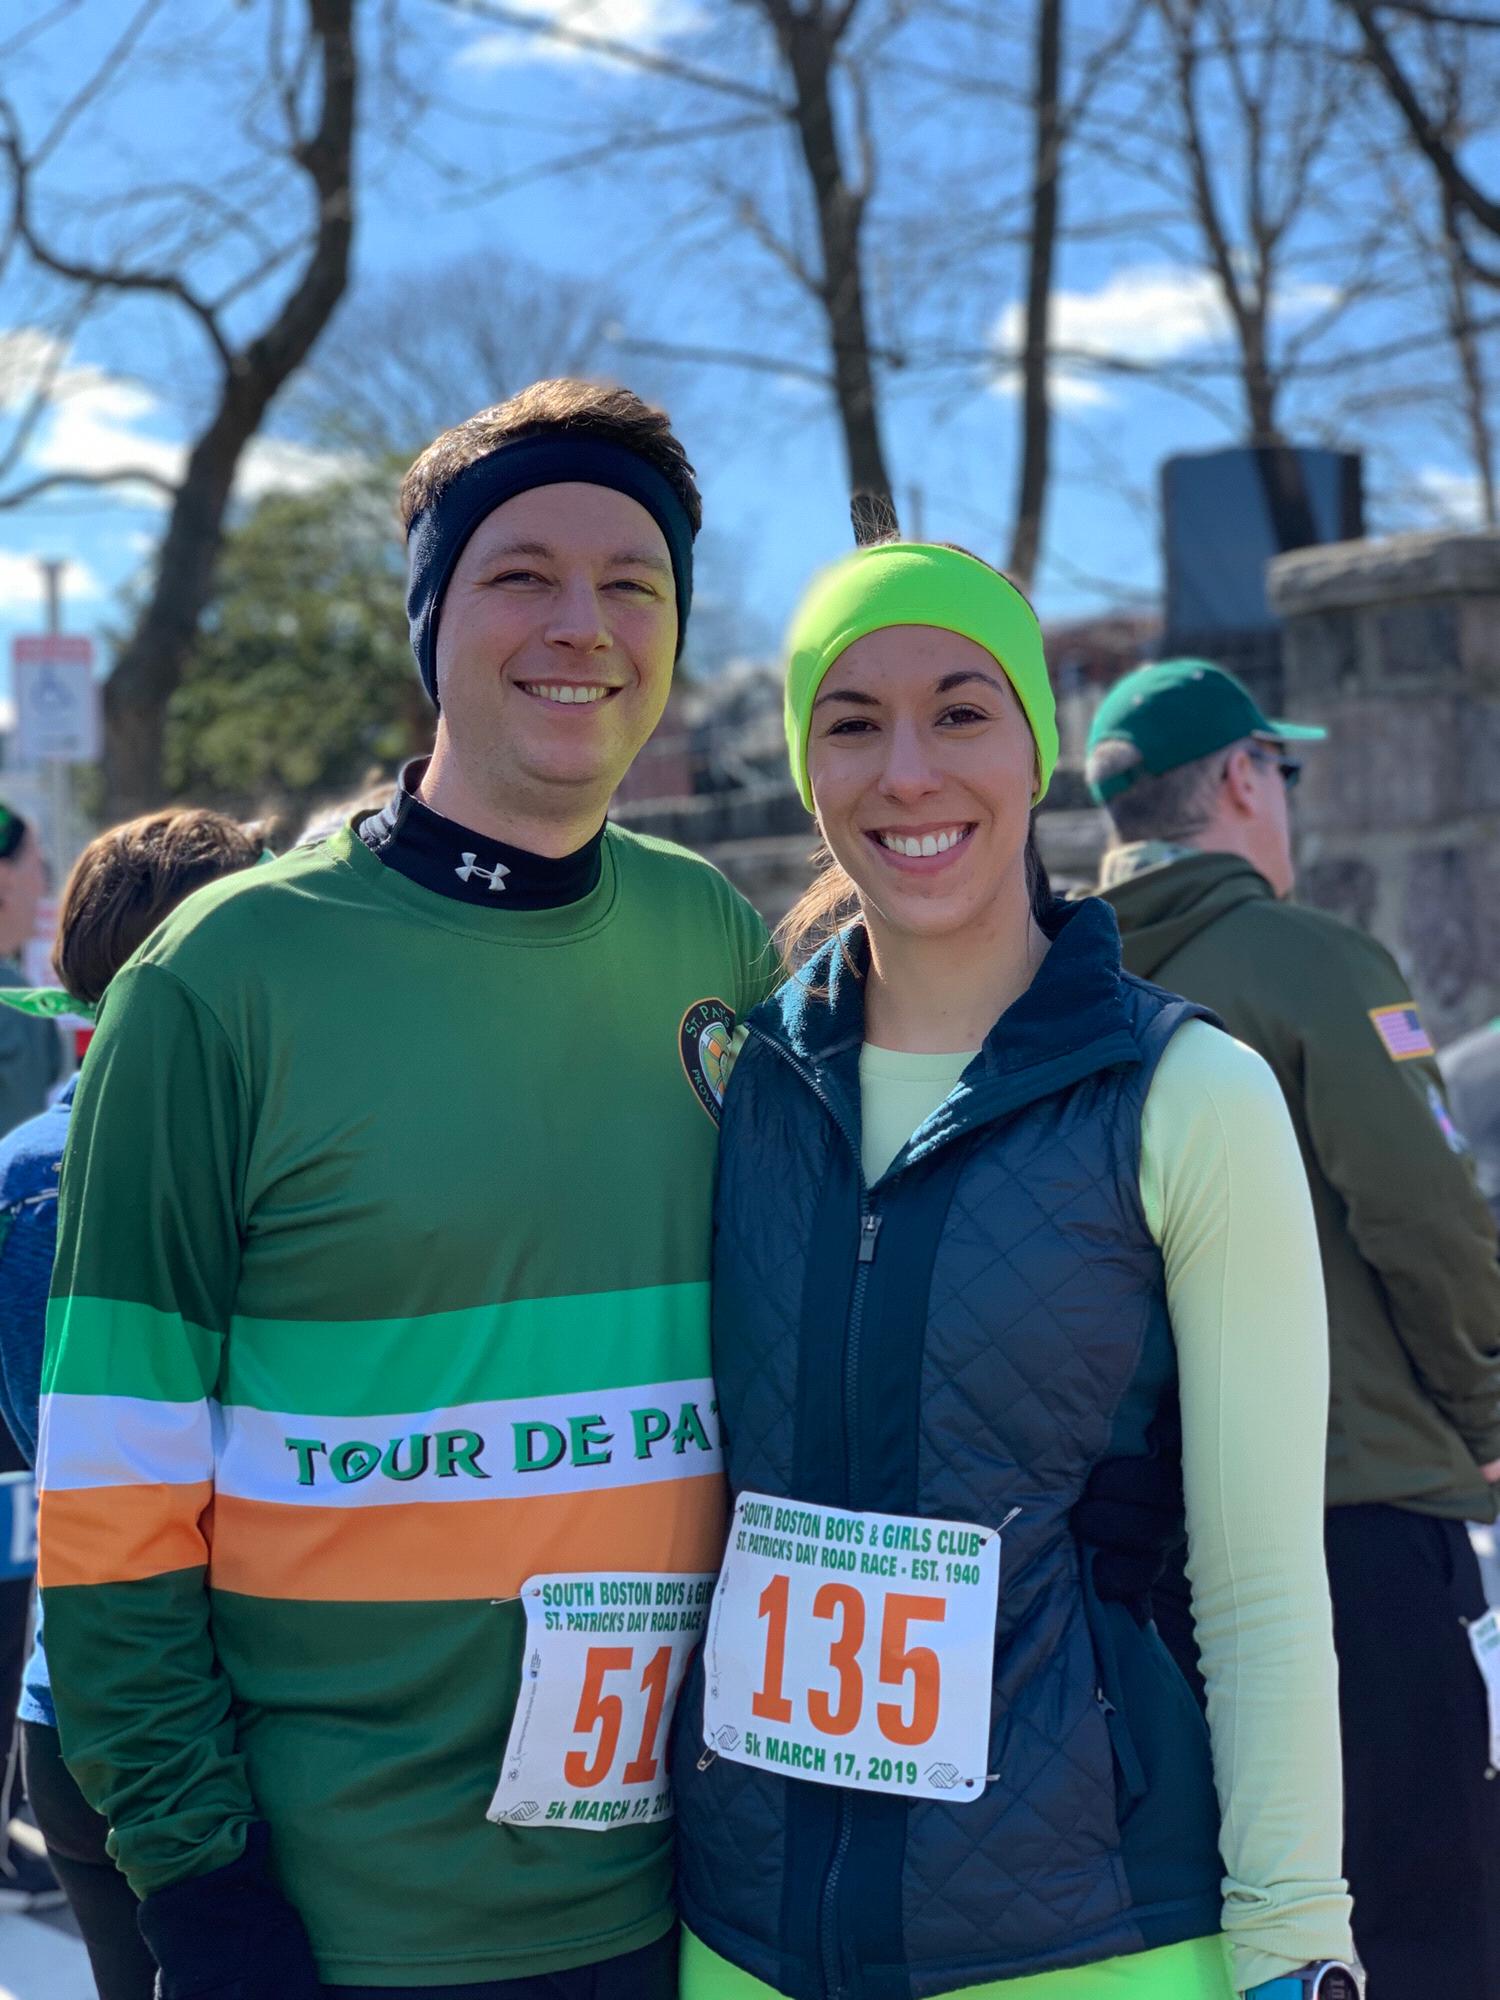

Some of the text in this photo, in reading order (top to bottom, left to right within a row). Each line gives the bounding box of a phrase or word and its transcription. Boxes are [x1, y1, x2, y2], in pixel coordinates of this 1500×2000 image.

[285, 1400, 719, 1486] TOUR DE PA
[742, 1501, 981, 1557] SOUTH BOSTON BOYS & GIRLS CLUB
[736, 1530, 746, 1553] ST.
[747, 1533, 794, 1561] PATRICK'S
[795, 1542, 819, 1566] DAY
[821, 1546, 857, 1572] ROAD
[860, 1552, 898, 1577] RACE
[911, 1558, 939, 1582] EST.
[945, 1562, 980, 1585] 1940
[542, 1582, 594, 1607] SOUTH
[600, 1581, 652, 1606] BOSTON
[655, 1581, 686, 1606] BOYS
[544, 1611, 563, 1631] ST.
[566, 1611, 625, 1632] PATRICK'S
[627, 1611, 650, 1632] DAY
[651, 1611, 678, 1632] ROAD
[752, 1573, 947, 1746] 135
[564, 1646, 688, 1789] 51
[745, 1732, 918, 1785] 5k MARCH 17, 2019
[569, 1799, 630, 1822] MARCH
